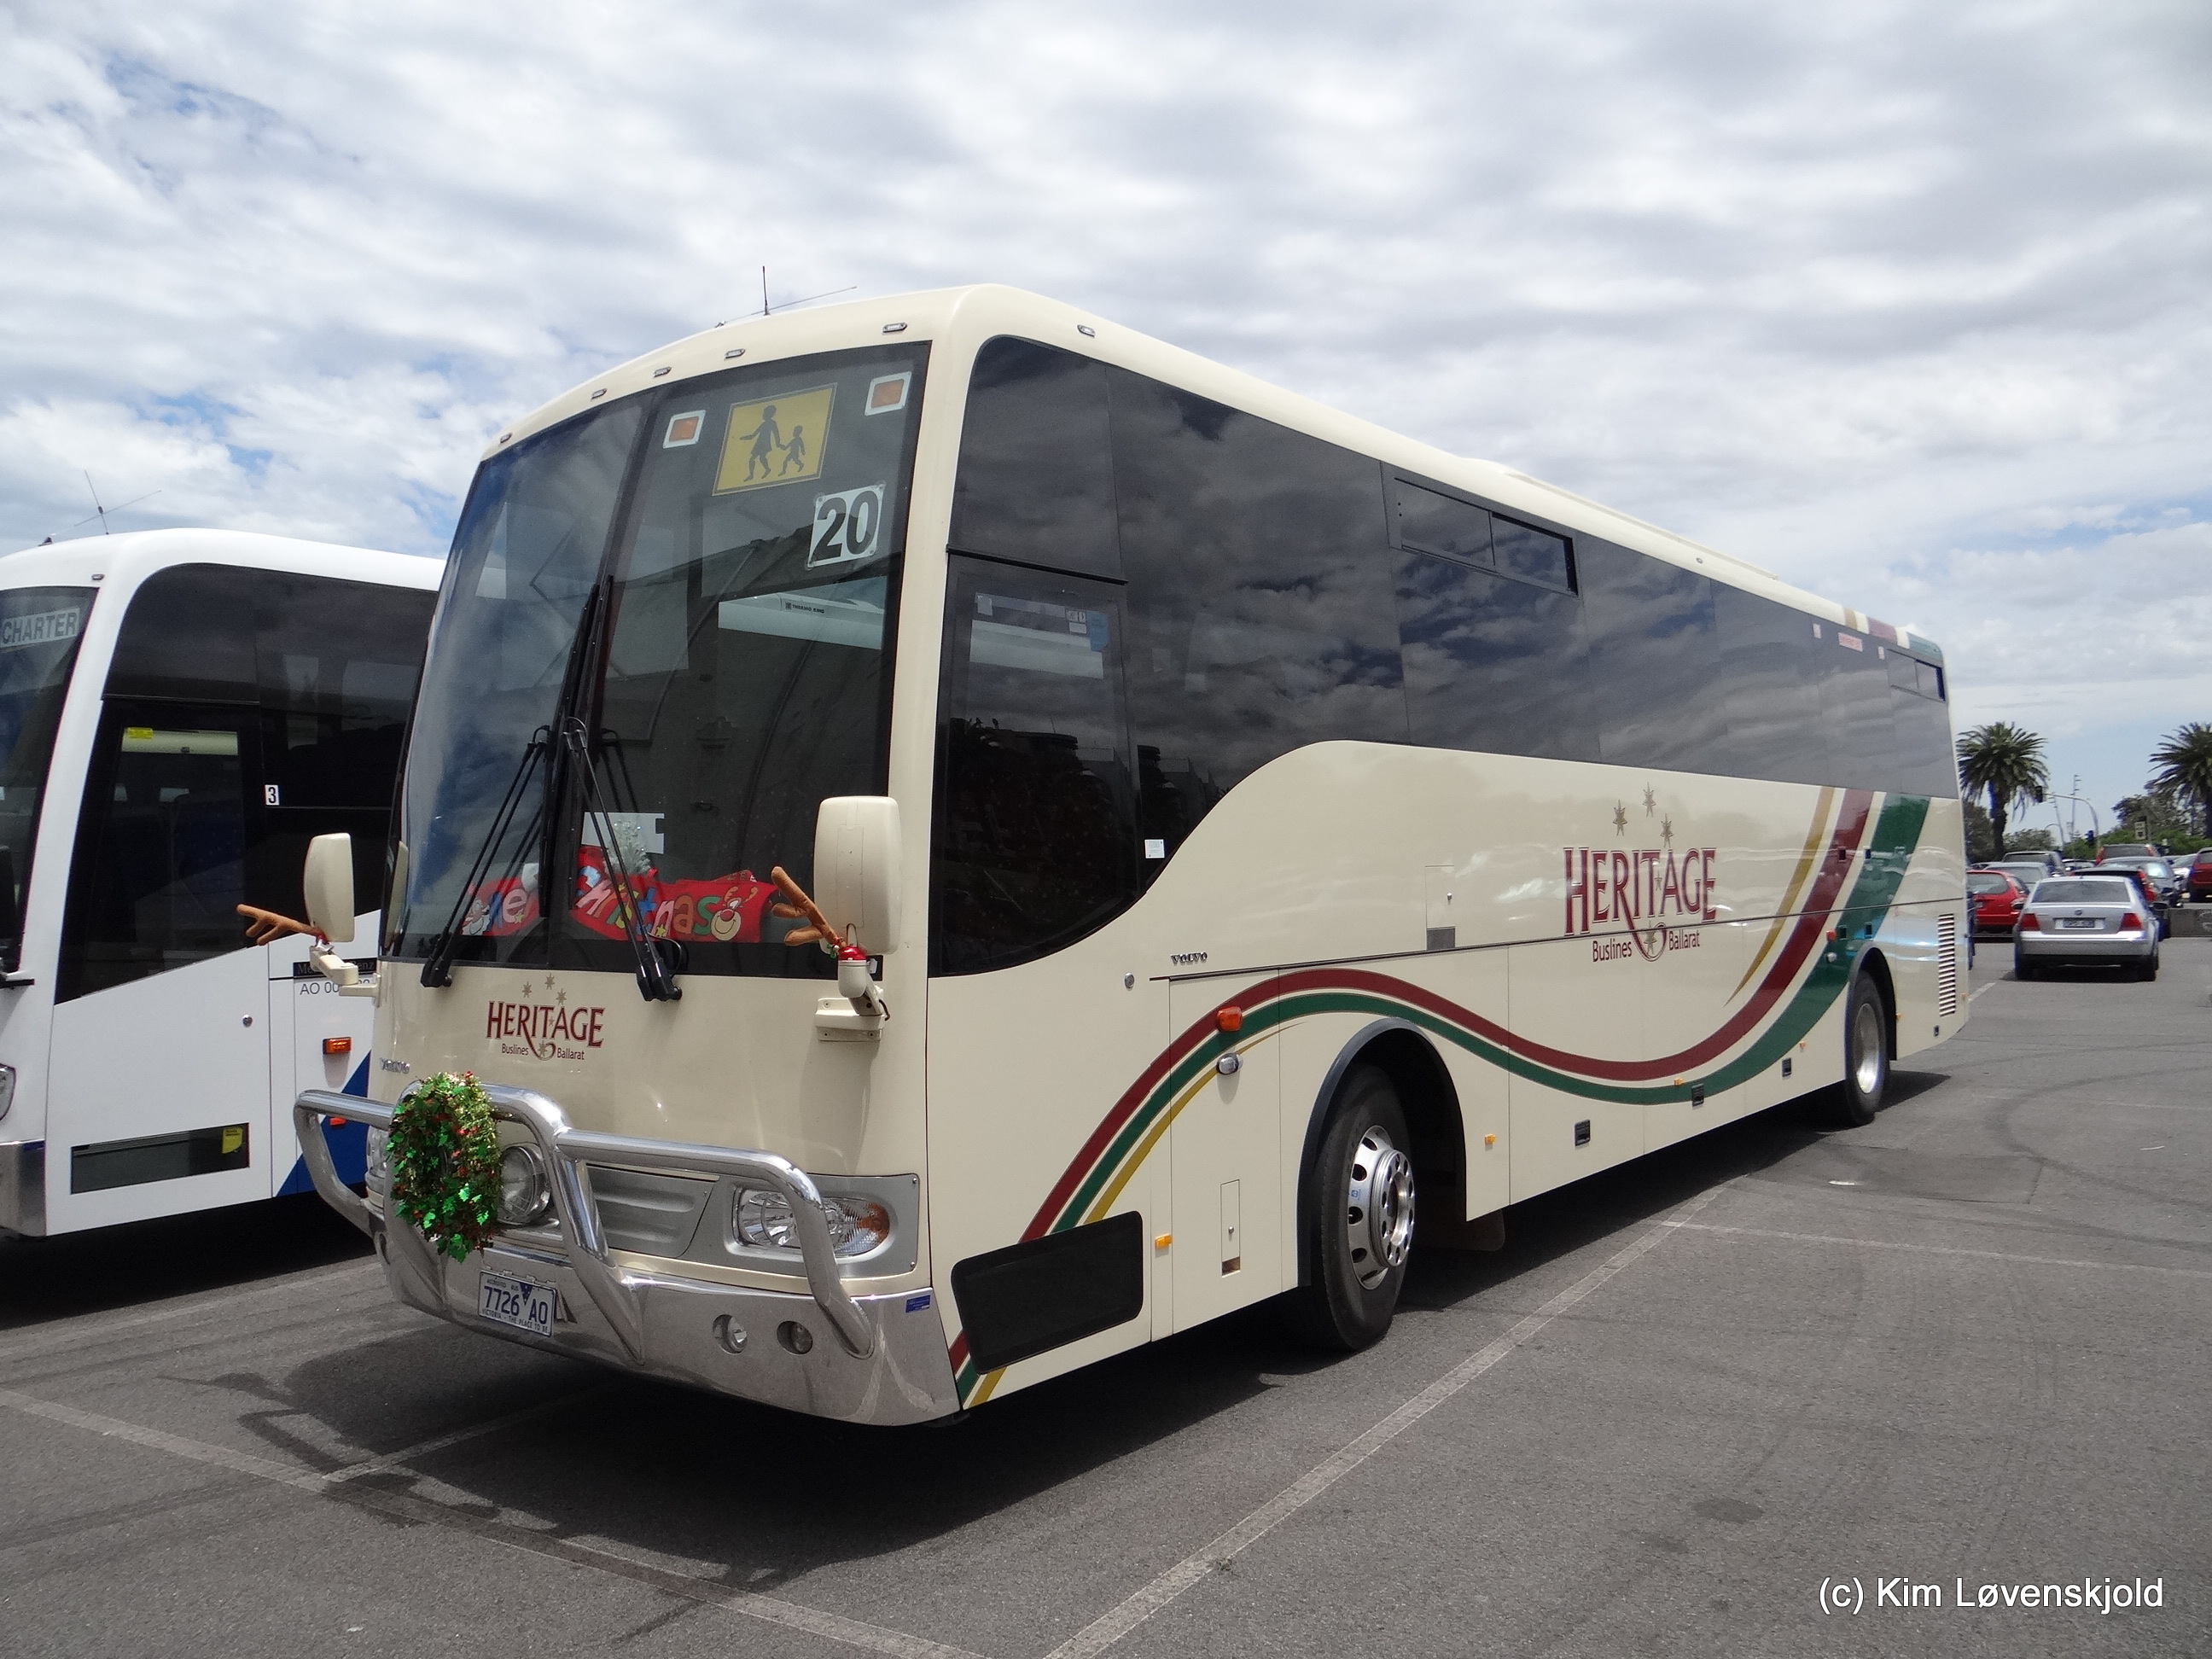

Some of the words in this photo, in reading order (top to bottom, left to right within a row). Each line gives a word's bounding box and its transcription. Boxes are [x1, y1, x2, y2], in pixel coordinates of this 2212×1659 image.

[809, 490, 879, 565] 20
[2, 612, 78, 644] CHARTER
[268, 786, 276, 803] 3
[1563, 847, 1716, 962] HERITAGE
[1170, 952, 1208, 964] VOLVO
[1592, 939, 1633, 963] Buslines
[1668, 929, 1701, 952] Ballarat
[300, 982, 321, 995] AO
[486, 1000, 605, 1061] HERITAGE
[501, 1043, 529, 1056] Buslines
[556, 1047, 585, 1060] Ballarat
[481, 1308, 502, 1318] VICTORIA
[508, 1315, 517, 1324] THE
[518, 1318, 533, 1329] PLACE
[484, 1285, 520, 1316] 7726
[528, 1298, 549, 1324] AO
